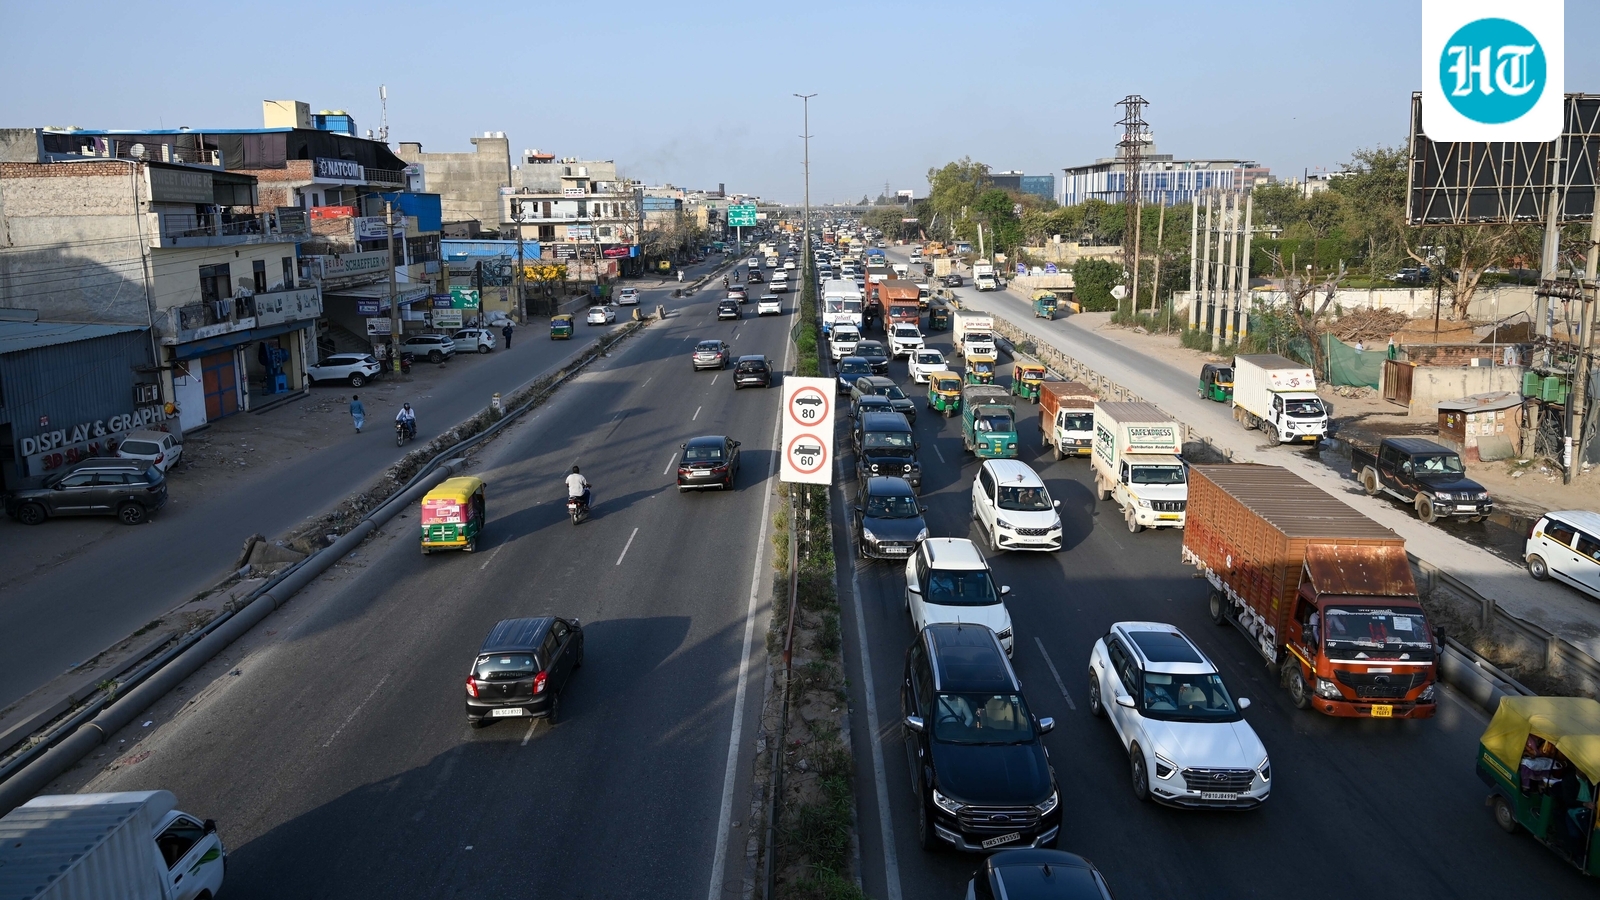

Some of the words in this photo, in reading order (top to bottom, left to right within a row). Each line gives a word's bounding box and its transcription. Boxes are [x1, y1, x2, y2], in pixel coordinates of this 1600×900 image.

[328, 161, 359, 177] NATCOM
[152, 170, 179, 186] SWEET
[180, 173, 202, 187] HOME
[203, 175, 213, 188] PG
[345, 256, 380, 272] SCHAEFFLER
[802, 408, 815, 419] 80
[21, 423, 91, 456] DISPLAY
[93, 420, 106, 437] &
[1130, 428, 1172, 437] SAFEXPRESS
[42, 452, 64, 472] 3D
[800, 455, 814, 466] 60
